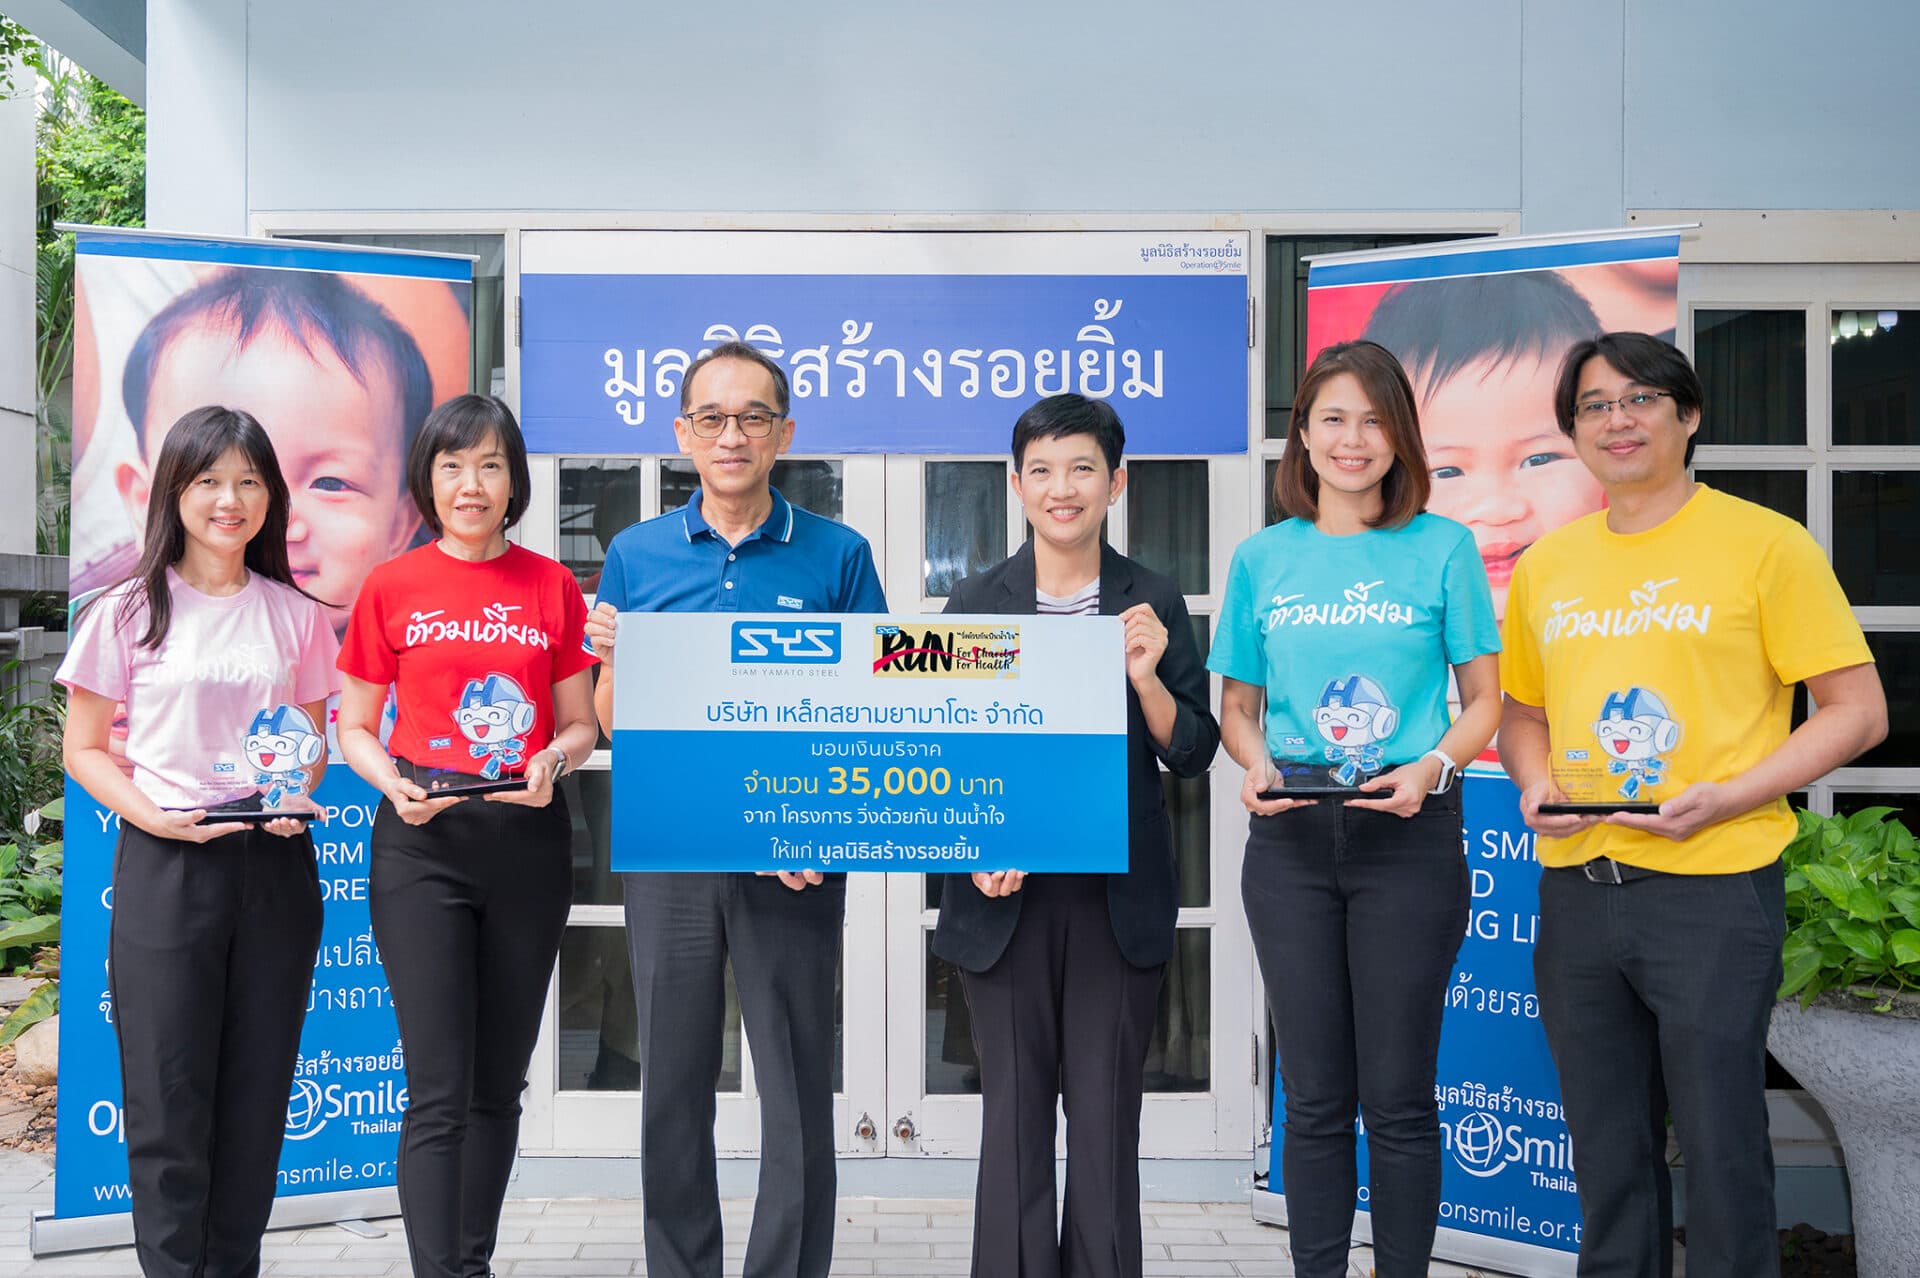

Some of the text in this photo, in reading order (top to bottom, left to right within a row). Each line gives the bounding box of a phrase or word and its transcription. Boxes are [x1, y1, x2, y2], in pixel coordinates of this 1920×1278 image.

[1140, 239, 1242, 262] มูลนิธิสร้างรอยยิ้ม
[604, 299, 1163, 425] มูลิิสร้างรอยยิ้ม
[1268, 580, 1413, 630] ต้วมเตี้ยม
[1543, 577, 1711, 645] ต้วมเตี้ยม
[405, 602, 548, 650] ต้วมเตี้ยม
[738, 628, 834, 657] SYS
[881, 629, 954, 672] RUN
[957, 646, 1016, 664] For Charity
[732, 668, 839, 677] SIAM YAMATO STEEL
[956, 658, 1010, 669] For Health
[707, 697, 1044, 725] บริษัท เหล็กสยามยามาโตะ จำกัด
[811, 740, 942, 757] มอบเงินบริจาค
[743, 766, 1003, 799] จำนวน 35,000 บาท
[743, 802, 1005, 825] จาก โครงการ วิ่งด้วยกัน ปันน้ำใจ
[770, 834, 980, 866] ให้แก่ มูลนิธิสร้างรอยยิ้ม
[324, 1079, 410, 1119] Smile
